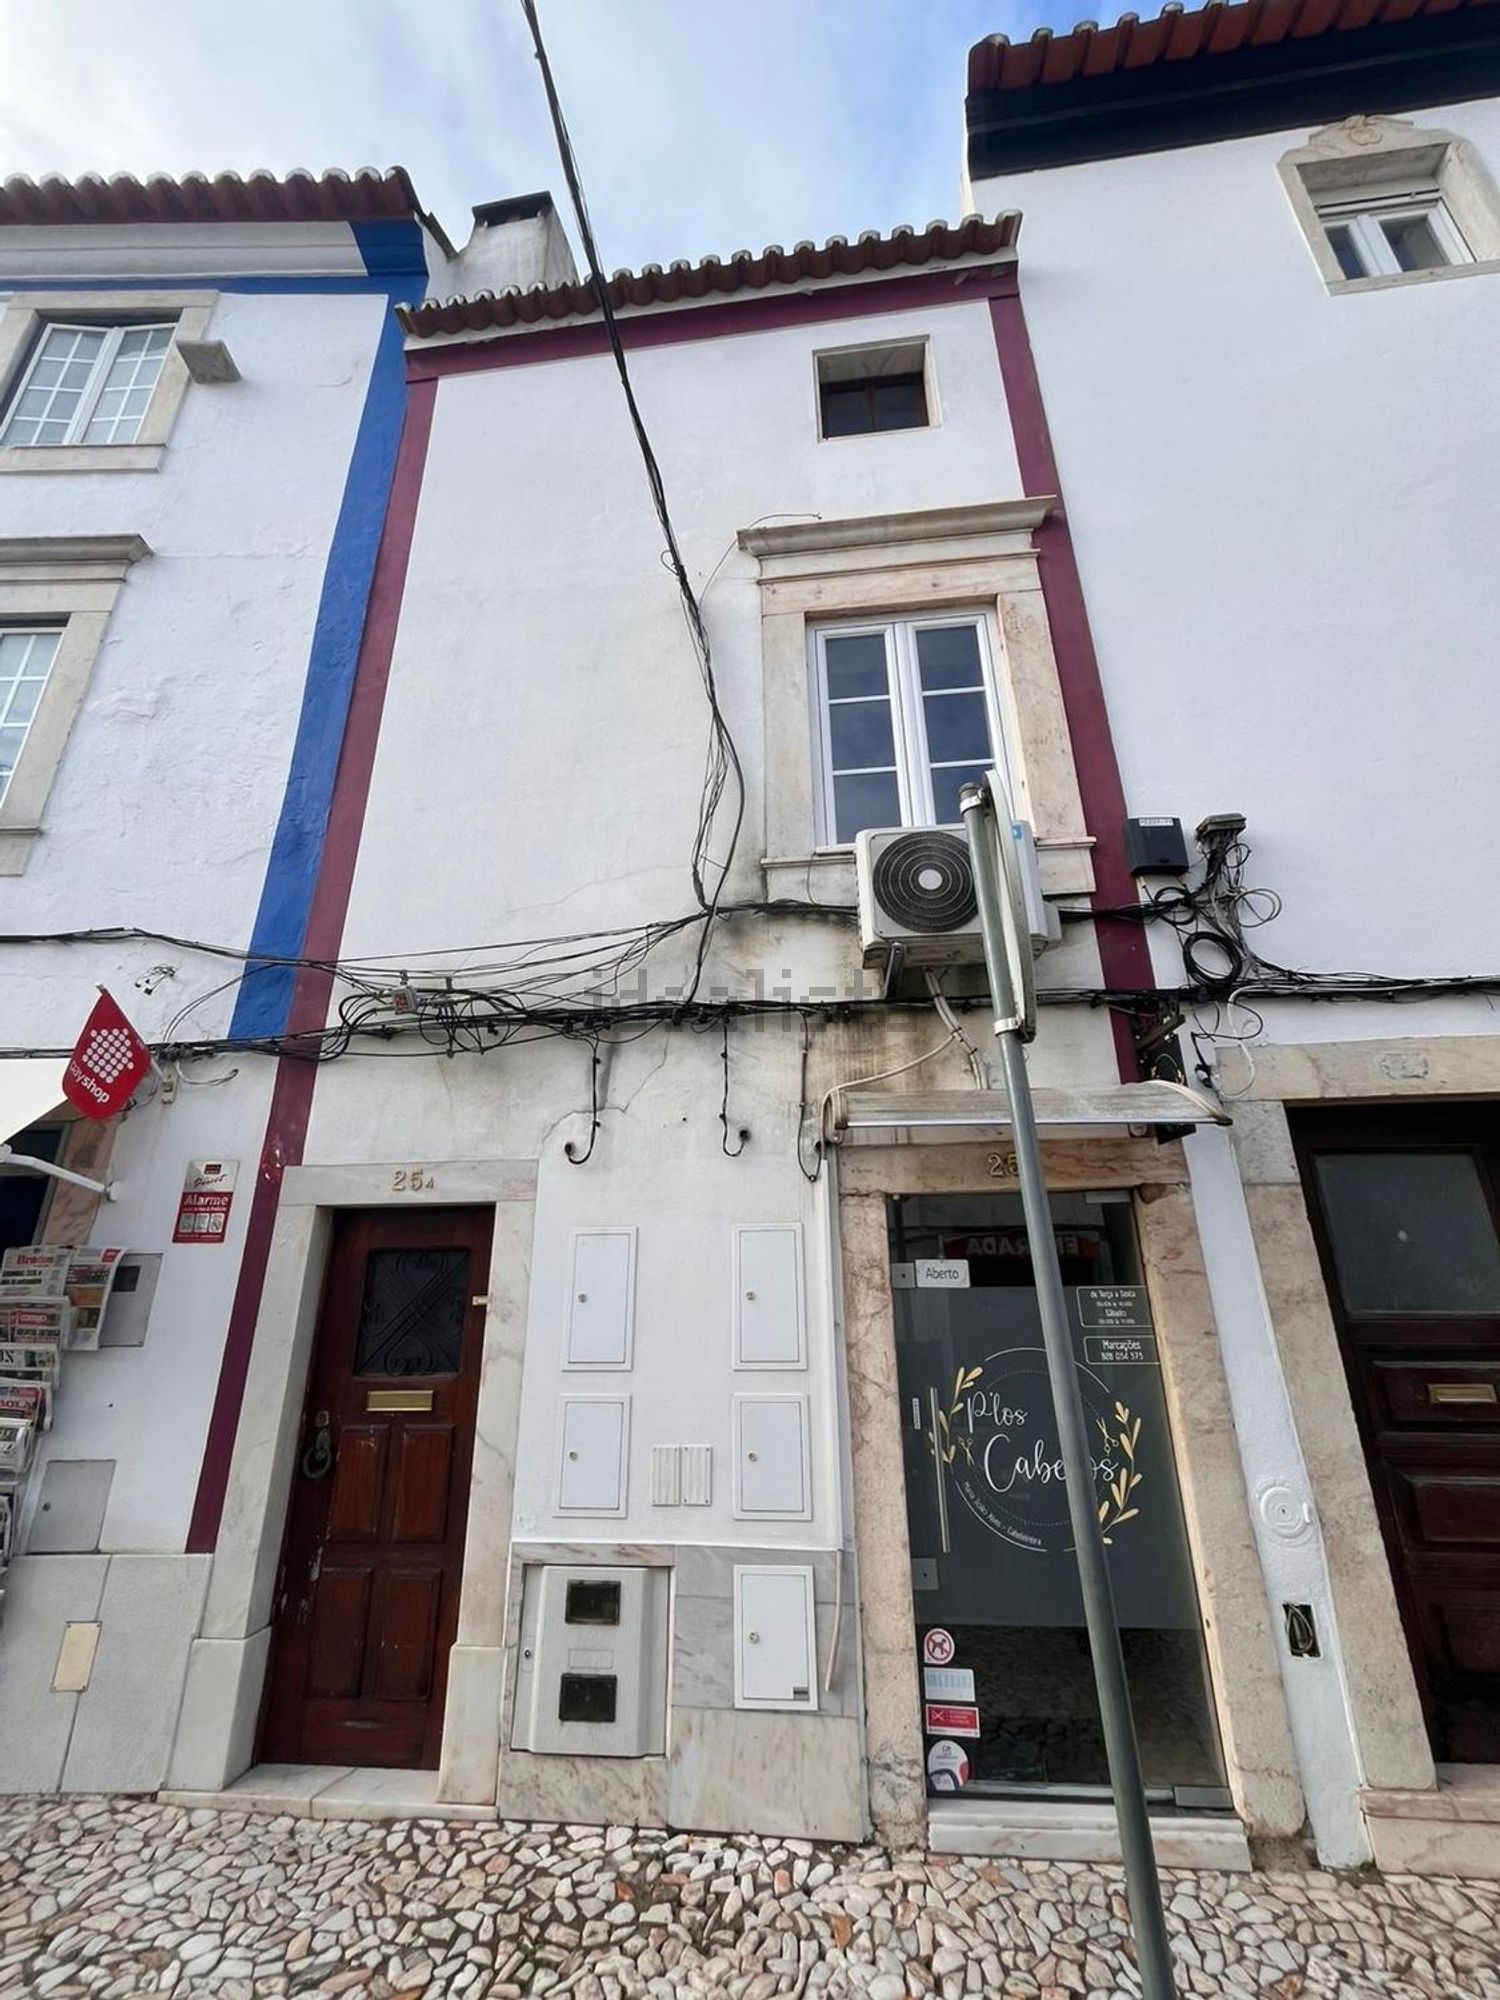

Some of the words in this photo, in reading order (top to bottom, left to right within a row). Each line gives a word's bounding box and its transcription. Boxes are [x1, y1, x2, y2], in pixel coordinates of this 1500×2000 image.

[184, 1193, 229, 1206] Alarme
[925, 1267, 960, 1280] Aberto
[1102, 1339, 1141, 1352] Marcações
